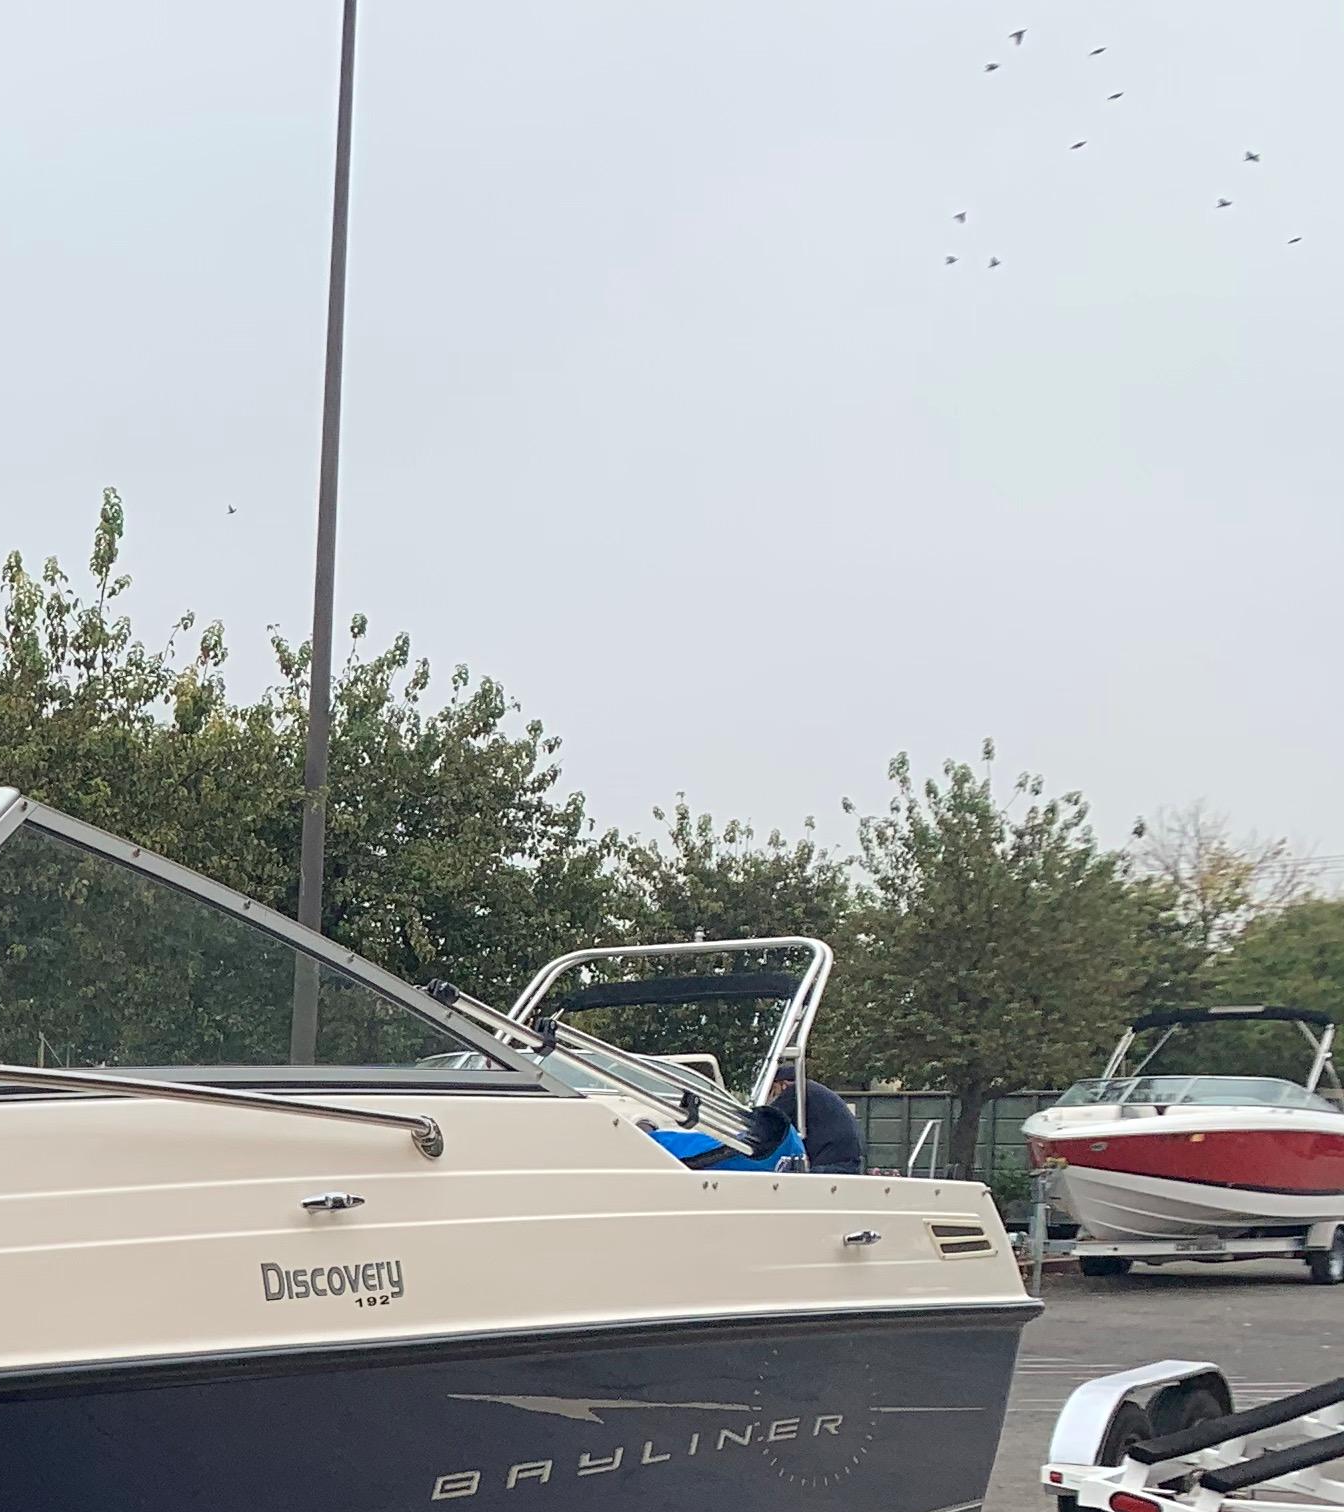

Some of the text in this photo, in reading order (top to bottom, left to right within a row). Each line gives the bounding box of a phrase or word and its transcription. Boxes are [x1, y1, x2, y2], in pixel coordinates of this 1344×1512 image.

[260, 1260, 405, 1302] Discovery
[354, 1294, 391, 1308] 192
[430, 1413, 845, 1501] BAYLINER
